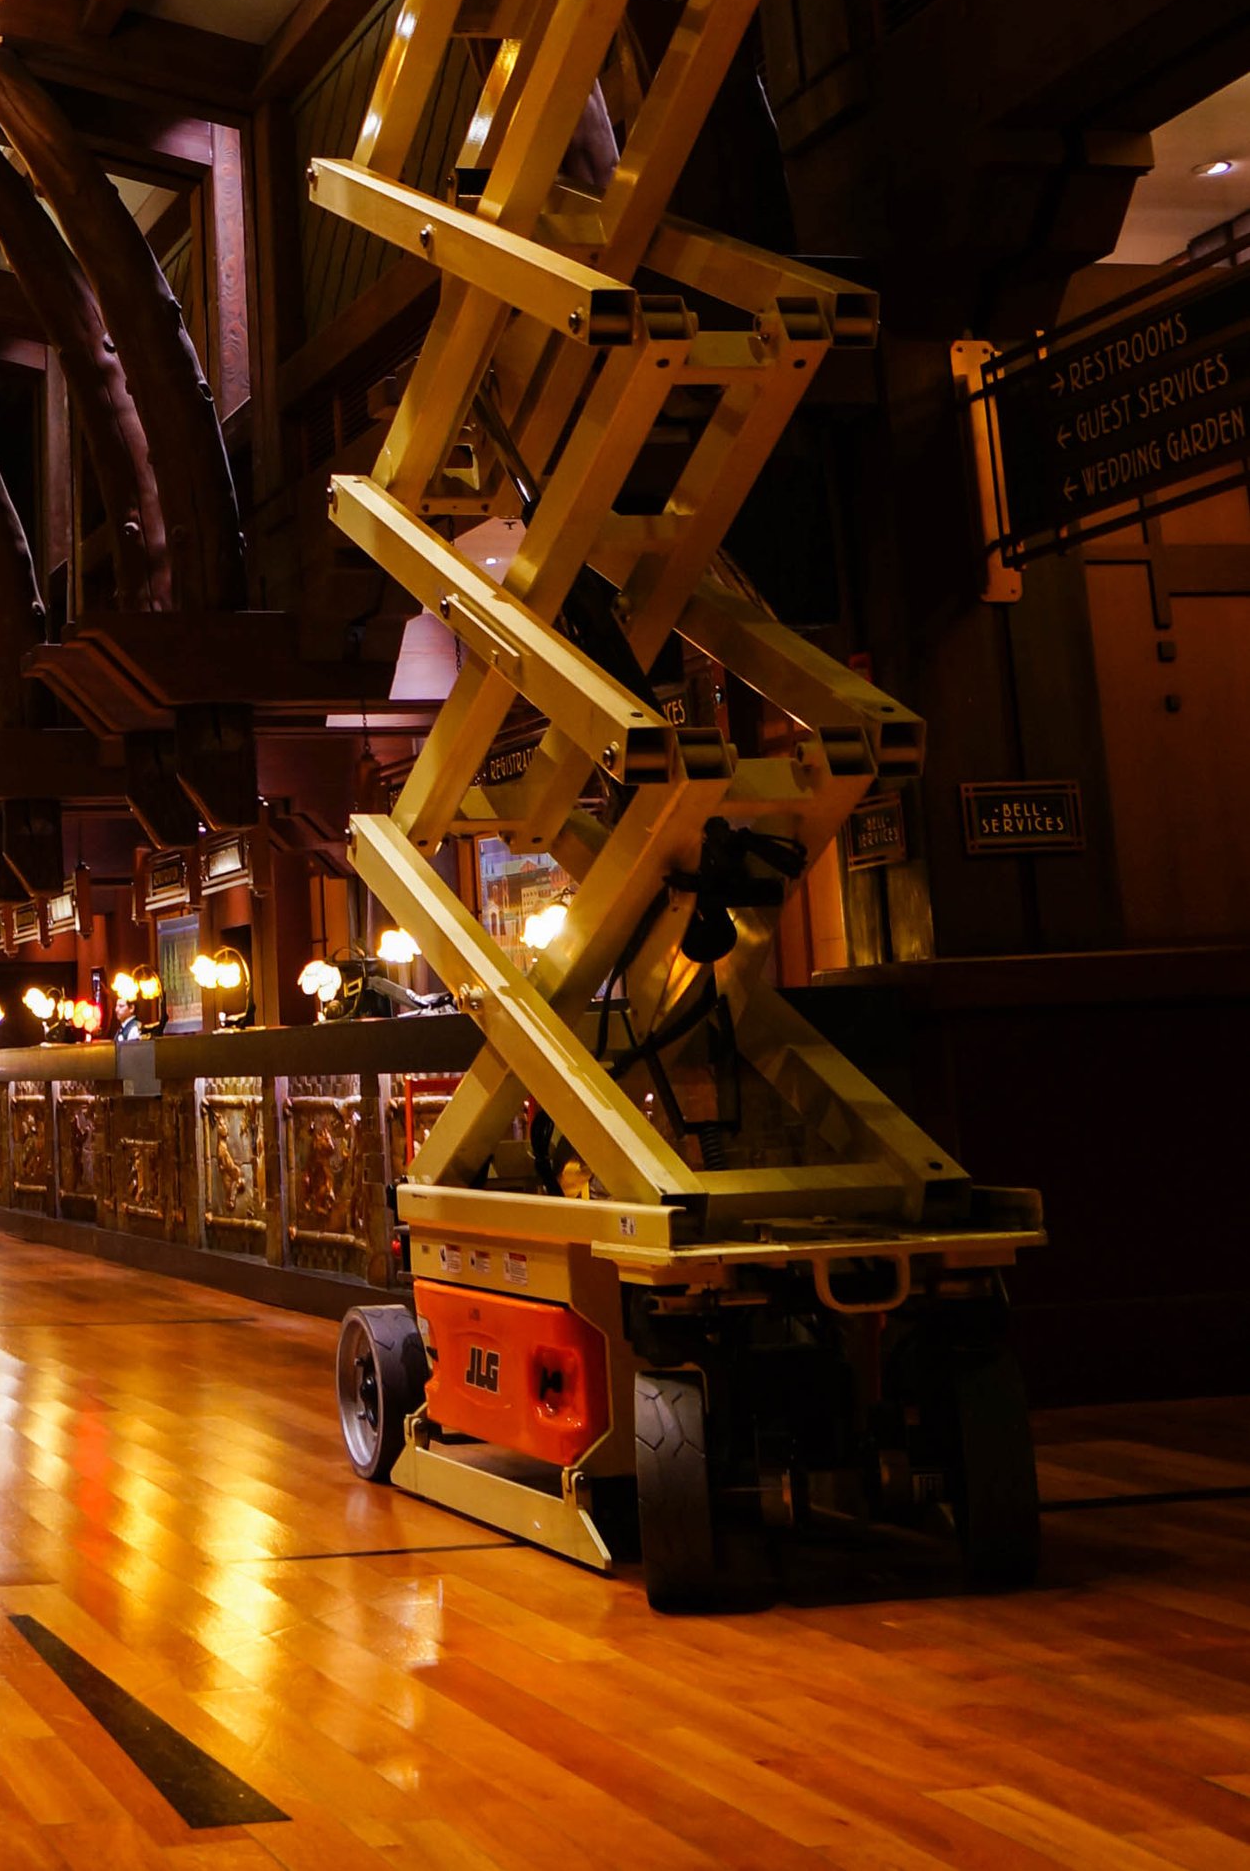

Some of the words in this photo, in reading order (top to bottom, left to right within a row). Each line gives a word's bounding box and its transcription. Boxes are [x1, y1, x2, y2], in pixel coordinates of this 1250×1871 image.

[1069, 311, 1189, 393] RESTROOMS
[1075, 393, 1132, 443] GUEST
[1137, 352, 1230, 419] SERVICES
[1081, 439, 1163, 498] WEDDING
[1166, 405, 1247, 463] GARDEN
[981, 816, 1065, 834] SERVICES
[1002, 802, 1041, 818] BELL
[464, 1345, 501, 1395] JLG
